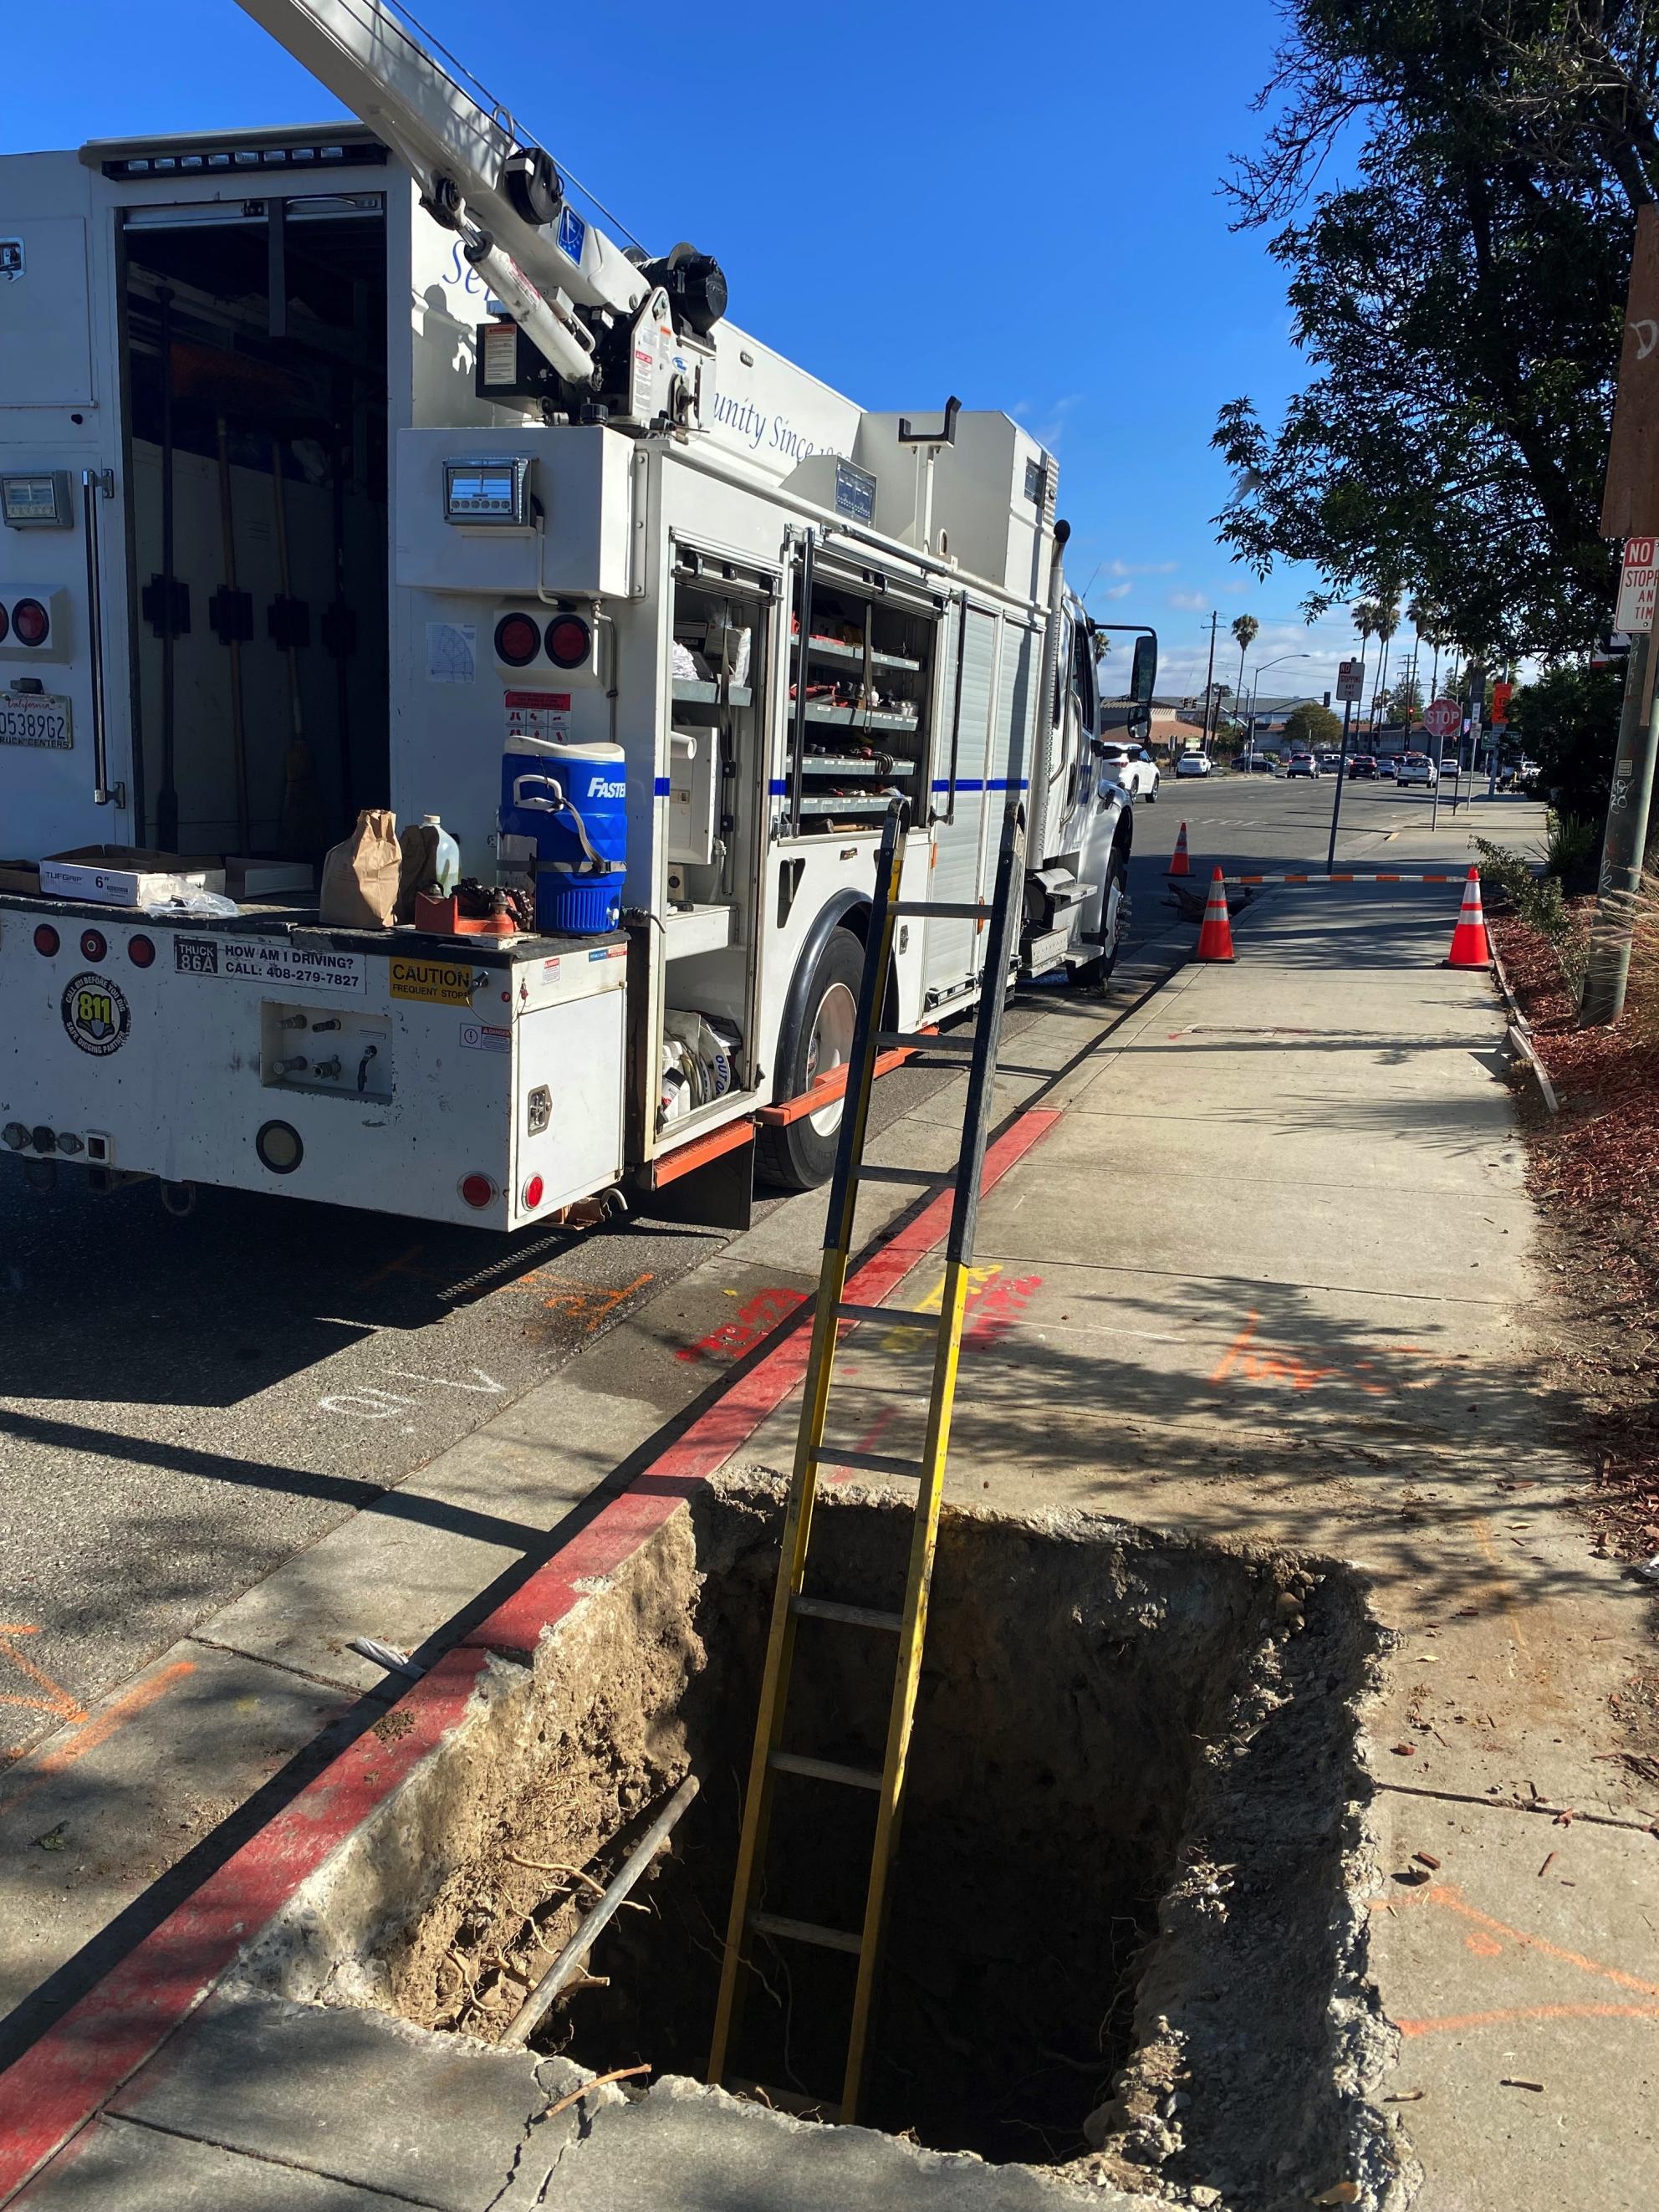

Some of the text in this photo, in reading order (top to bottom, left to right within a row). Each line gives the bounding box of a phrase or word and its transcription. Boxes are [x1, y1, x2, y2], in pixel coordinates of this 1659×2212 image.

[713, 392, 814, 461] unity Since
[1629, 542, 1651, 563] NO
[1639, 590, 1654, 602] AN
[1635, 606, 1654, 619] TIM
[1340, 663, 1350, 673] NO
[1340, 675, 1361, 683] STOPPING
[1427, 710, 1459, 724] STOP
[0, 736, 24, 745] RUCK
[587, 777, 626, 798] FASTE
[45, 871, 83, 882] TUFGRIP
[179, 943, 215, 957] TRUCK
[225, 945, 354, 969] HOW AM I DRIVING?
[181, 954, 215, 973] 86A
[225, 962, 359, 987] CALL: 408-279-7827
[392, 963, 469, 988] CAUTION
[66, 987, 77, 1003] CALL
[84, 976, 108, 988] BEFORE
[107, 983, 120, 999] YOU
[117, 999, 126, 1012] DIG
[393, 983, 438, 996] FREQUENT
[79, 993, 110, 1025] 811
[66, 1021, 126, 1054] SAFE DIGGING PARTNER
[715, 1055, 727, 1082] OUT
